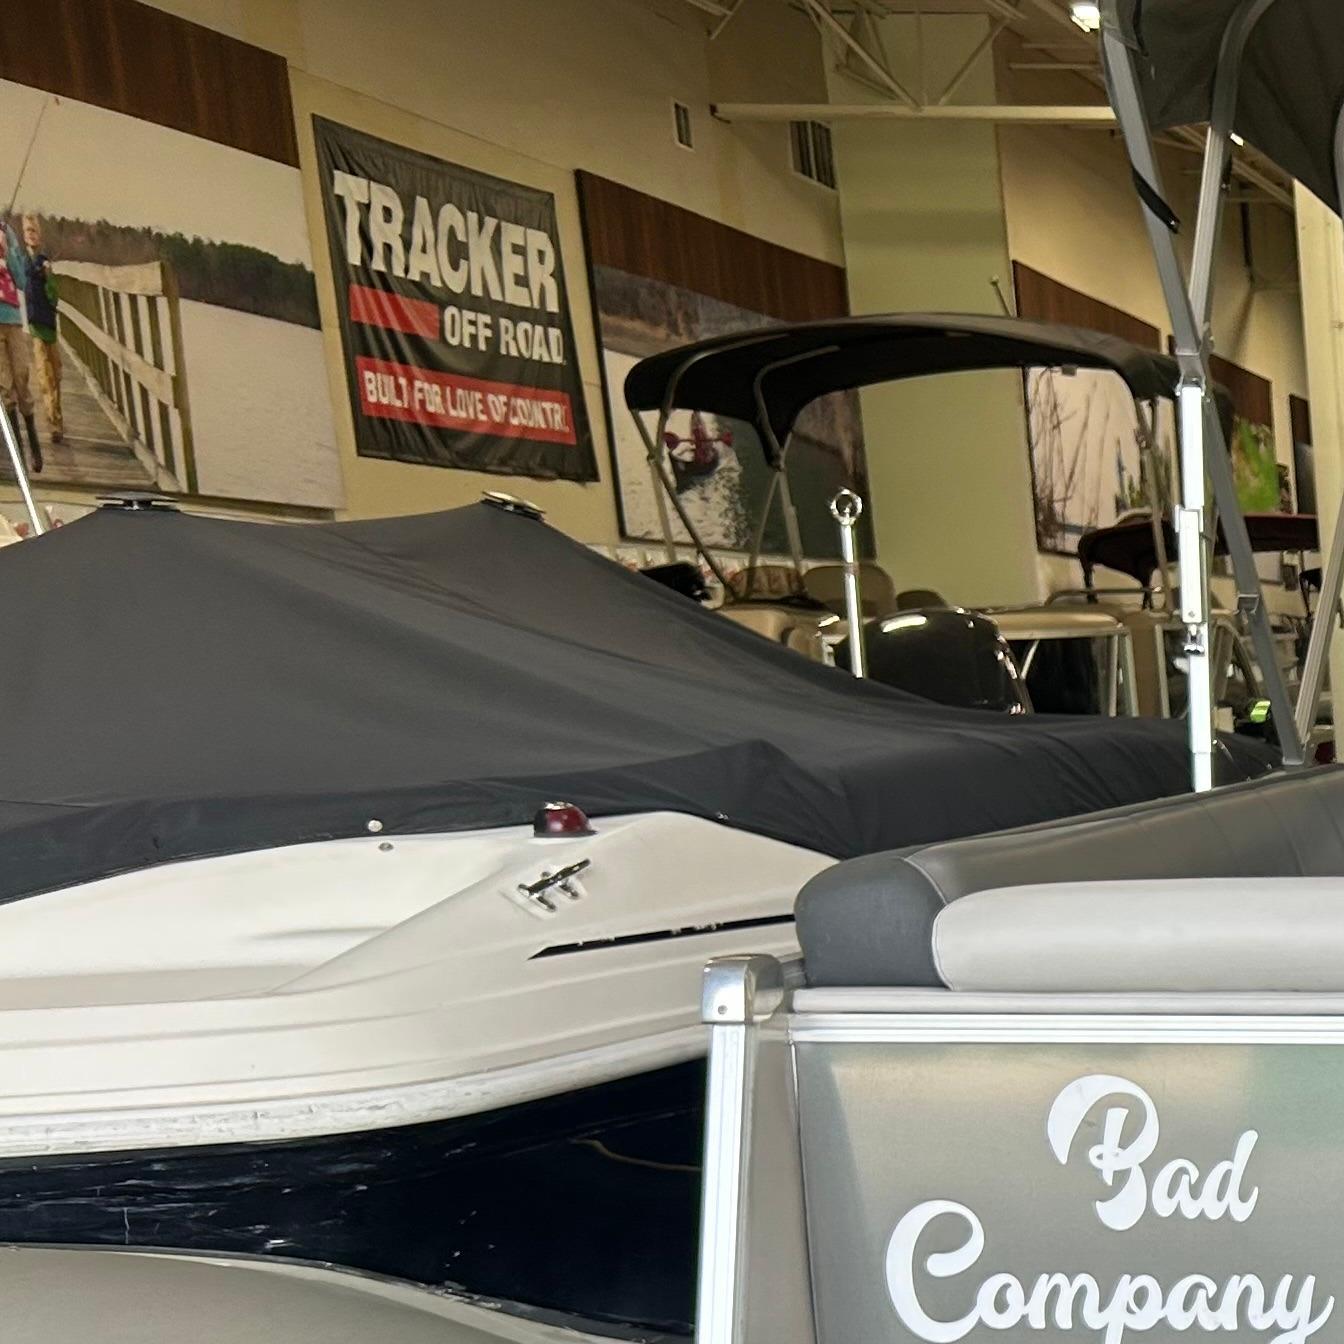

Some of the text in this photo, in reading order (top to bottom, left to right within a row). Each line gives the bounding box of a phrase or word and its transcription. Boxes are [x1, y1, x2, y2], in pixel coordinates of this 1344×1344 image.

[333, 168, 560, 313] TRACKER
[443, 305, 564, 365] OFF ROAD
[363, 369, 409, 409] BUILT
[412, 379, 446, 415] FOR
[446, 384, 488, 422] LOVE
[486, 393, 509, 423] OF
[1047, 1074, 1260, 1231] Bad
